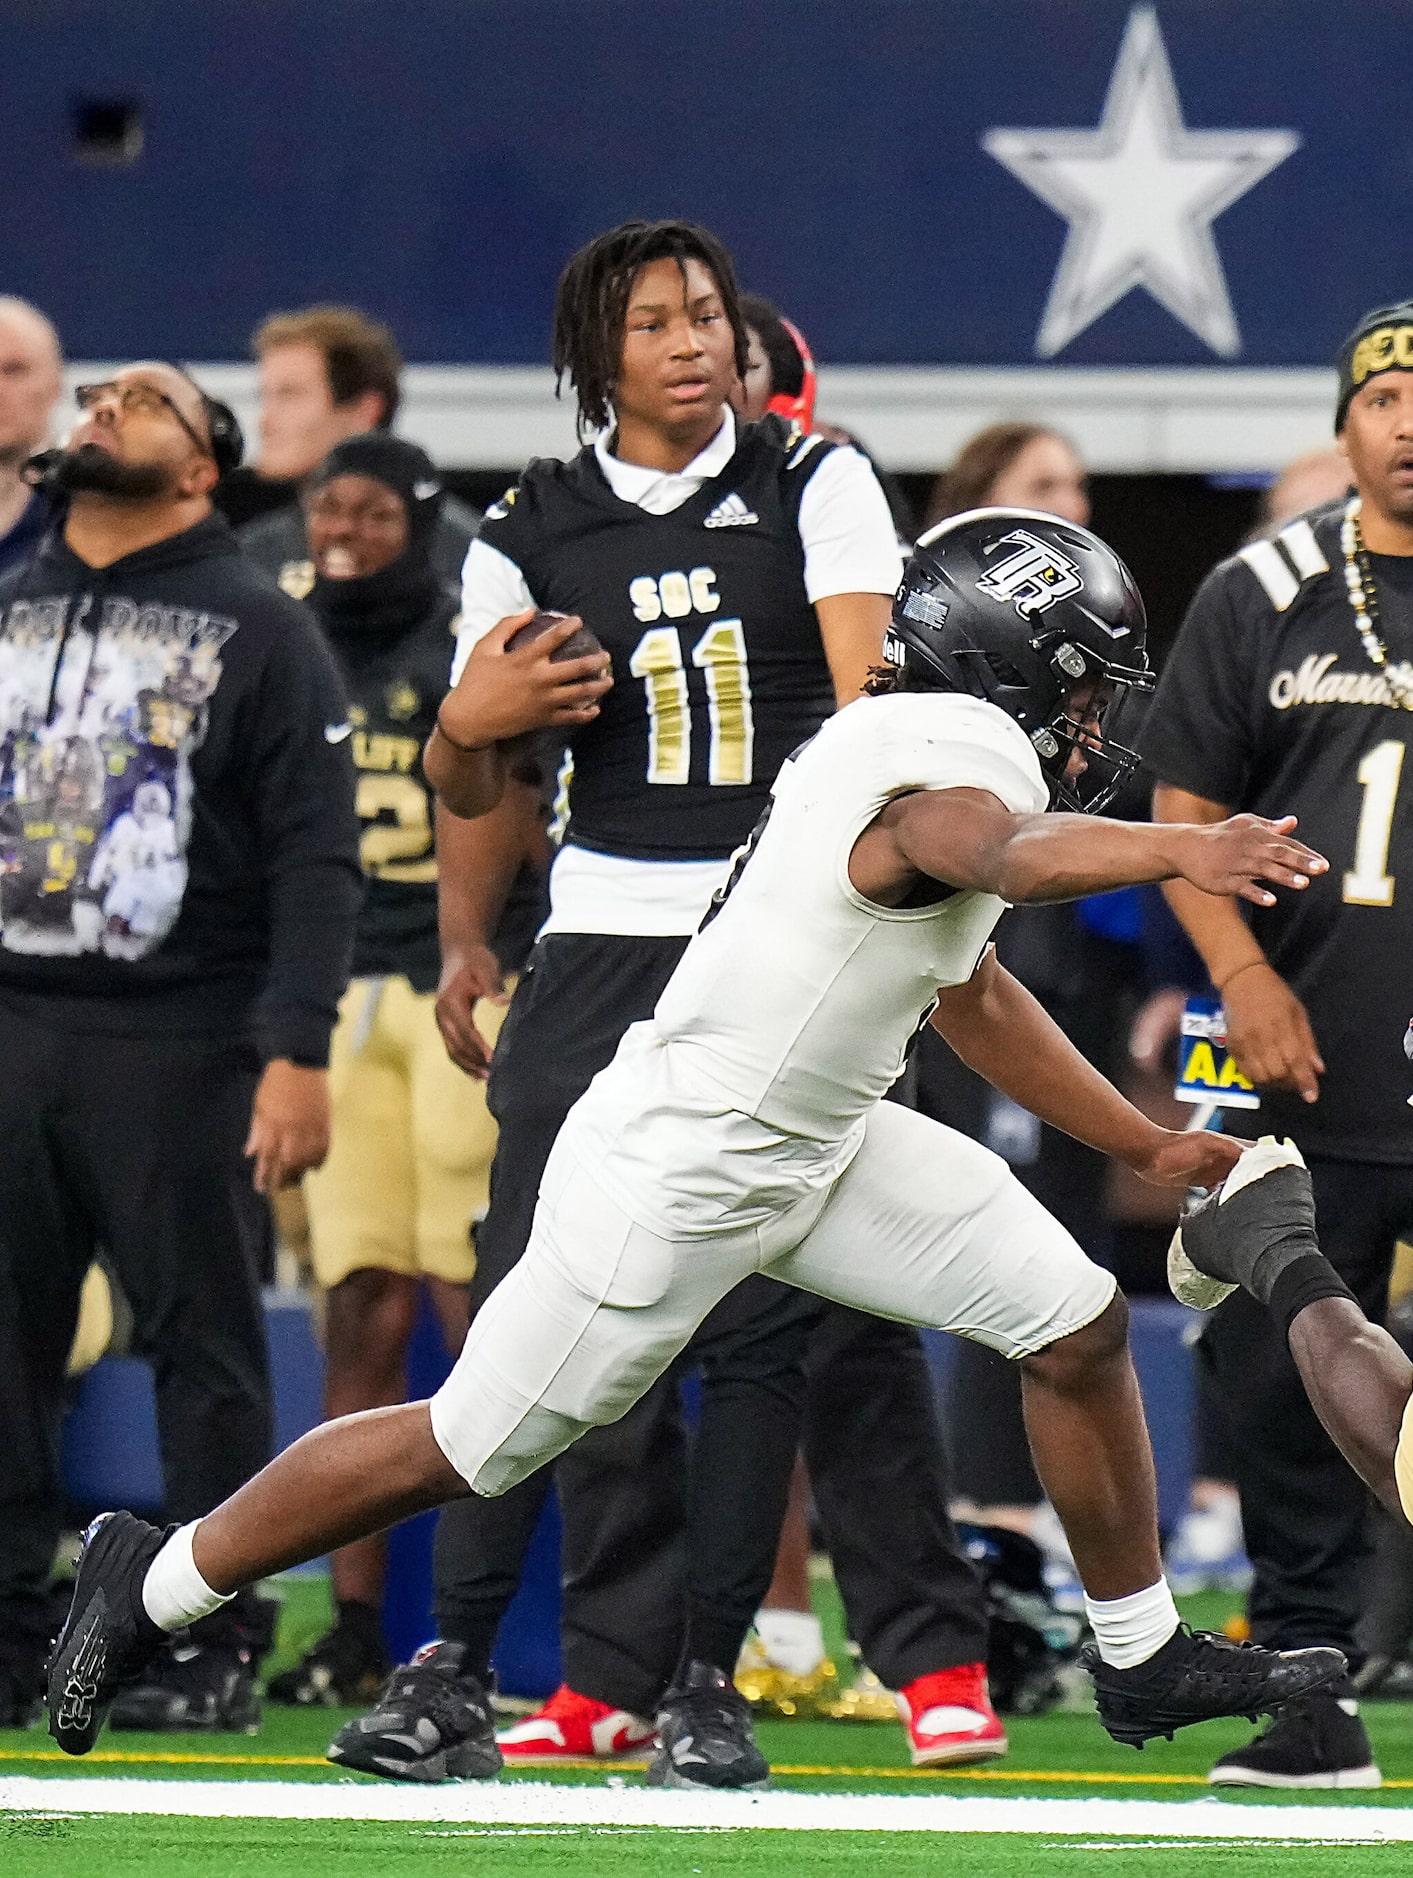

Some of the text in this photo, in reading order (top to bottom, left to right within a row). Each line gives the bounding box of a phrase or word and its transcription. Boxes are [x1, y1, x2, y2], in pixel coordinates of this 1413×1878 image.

[629, 565, 721, 622] SOC
[629, 617, 756, 786] 11
[1342, 738, 1406, 907] 1
